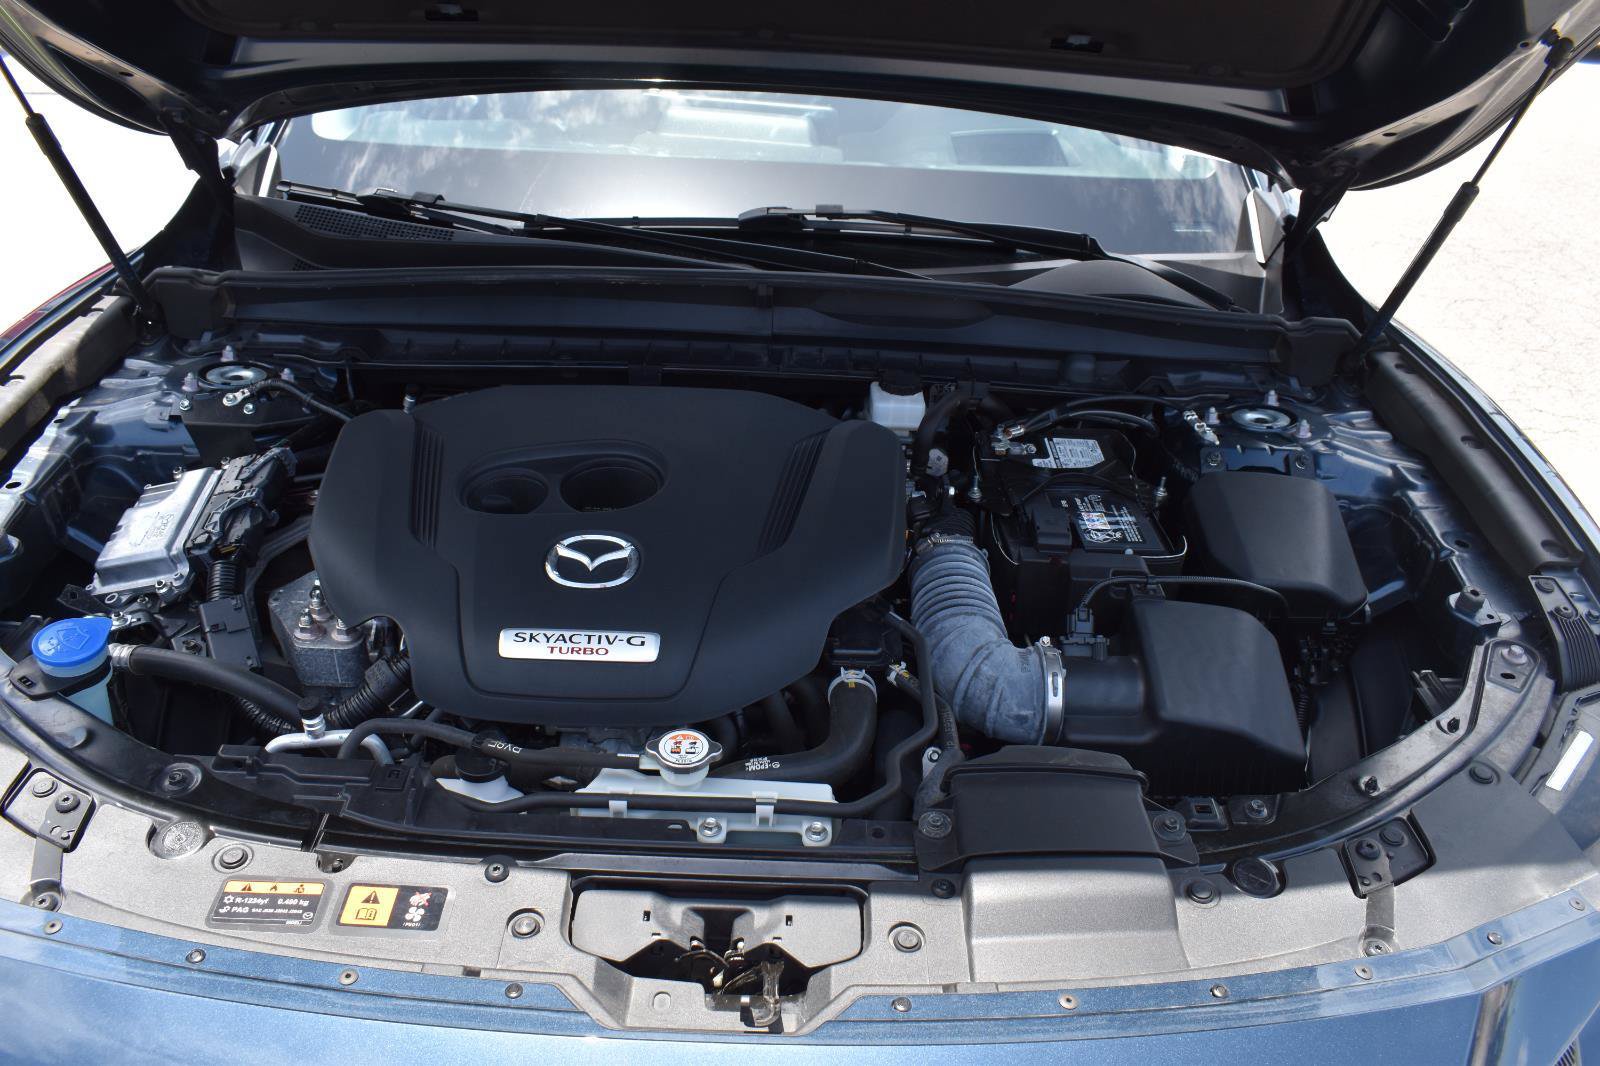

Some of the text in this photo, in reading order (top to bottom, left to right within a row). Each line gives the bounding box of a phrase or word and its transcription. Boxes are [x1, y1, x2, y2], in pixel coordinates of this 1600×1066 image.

[513, 632, 646, 647] SKYACTIV-G
[547, 646, 609, 656] TURBO
[235, 897, 269, 905] R-1234yf
